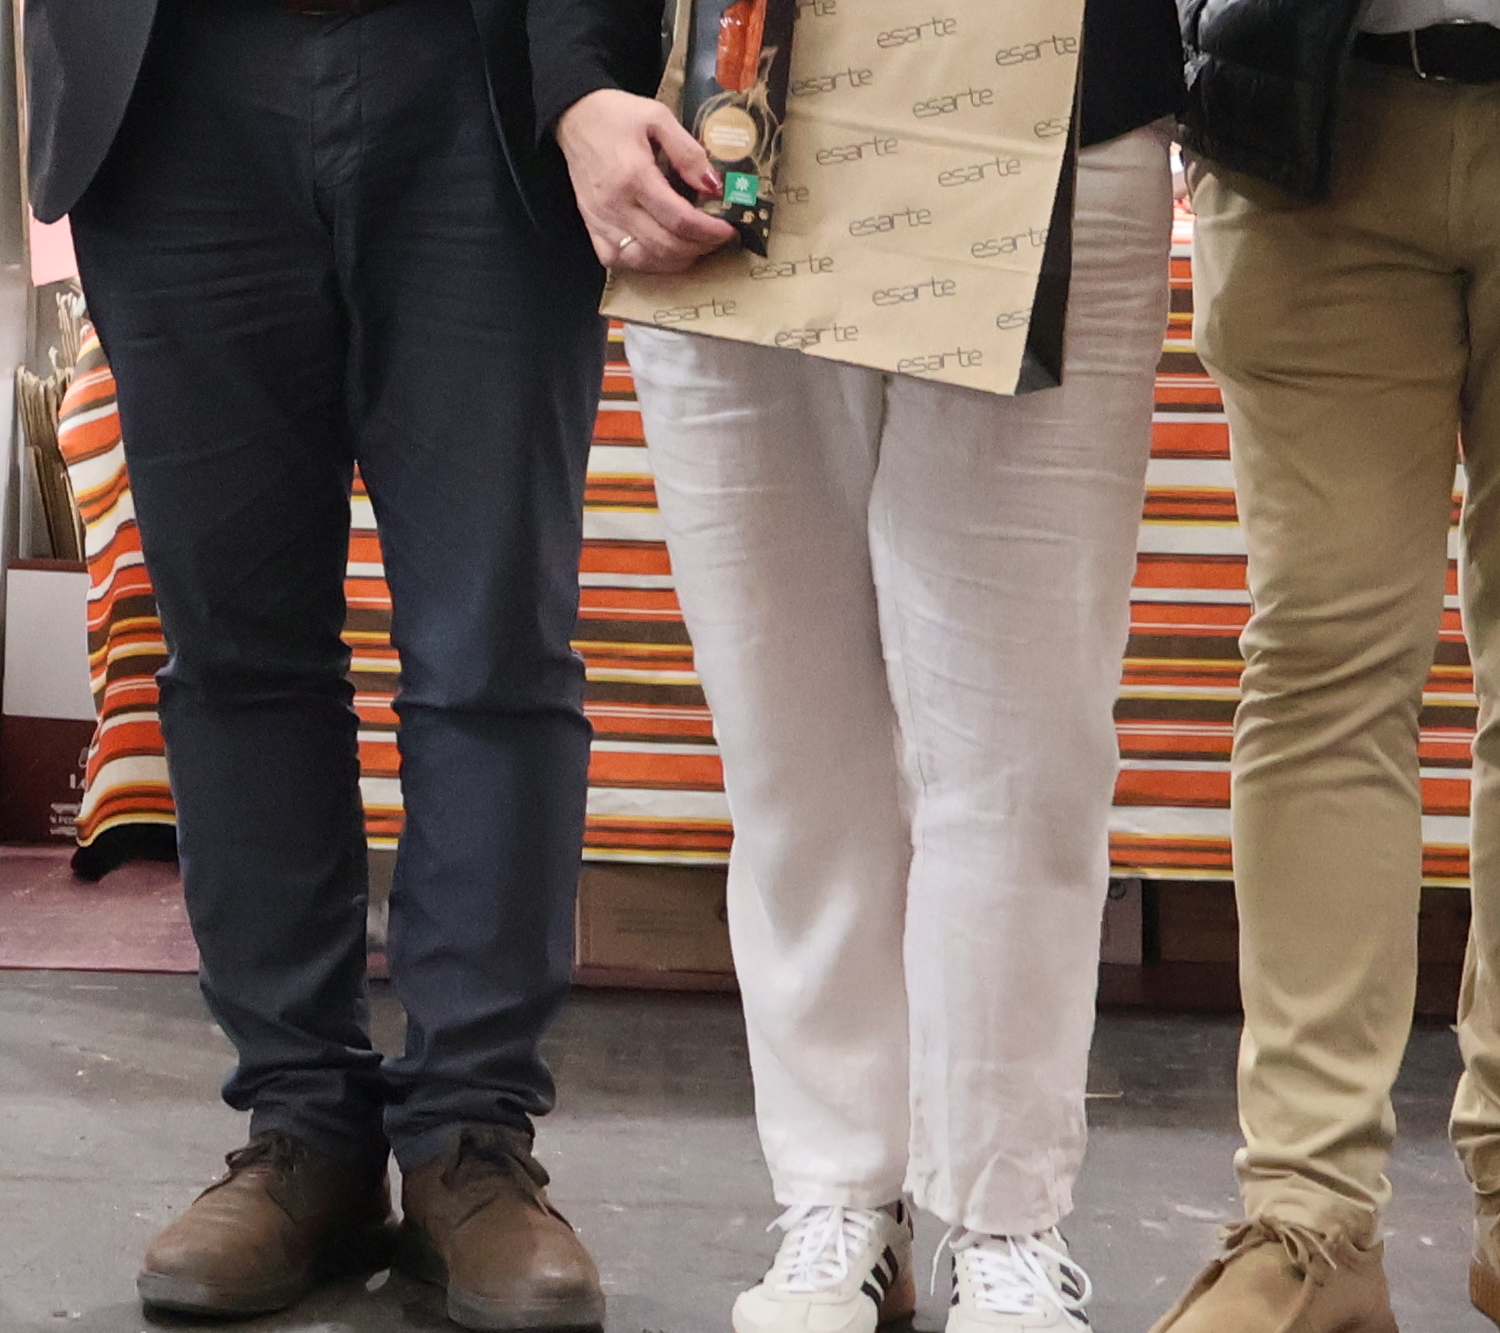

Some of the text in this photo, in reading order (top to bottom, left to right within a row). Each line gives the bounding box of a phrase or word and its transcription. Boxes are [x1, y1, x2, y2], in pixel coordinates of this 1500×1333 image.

[877, 17, 957, 48] esarte
[996, 35, 1078, 66] esarte
[912, 86, 994, 118] esarte
[816, 136, 898, 165] esarte
[938, 157, 1022, 187] esarte
[850, 207, 932, 236] esarte
[750, 254, 835, 280] esarte
[872, 277, 957, 307] esarte
[653, 298, 738, 324] esarte
[775, 323, 859, 349] esarte
[897, 347, 983, 373] esarte
